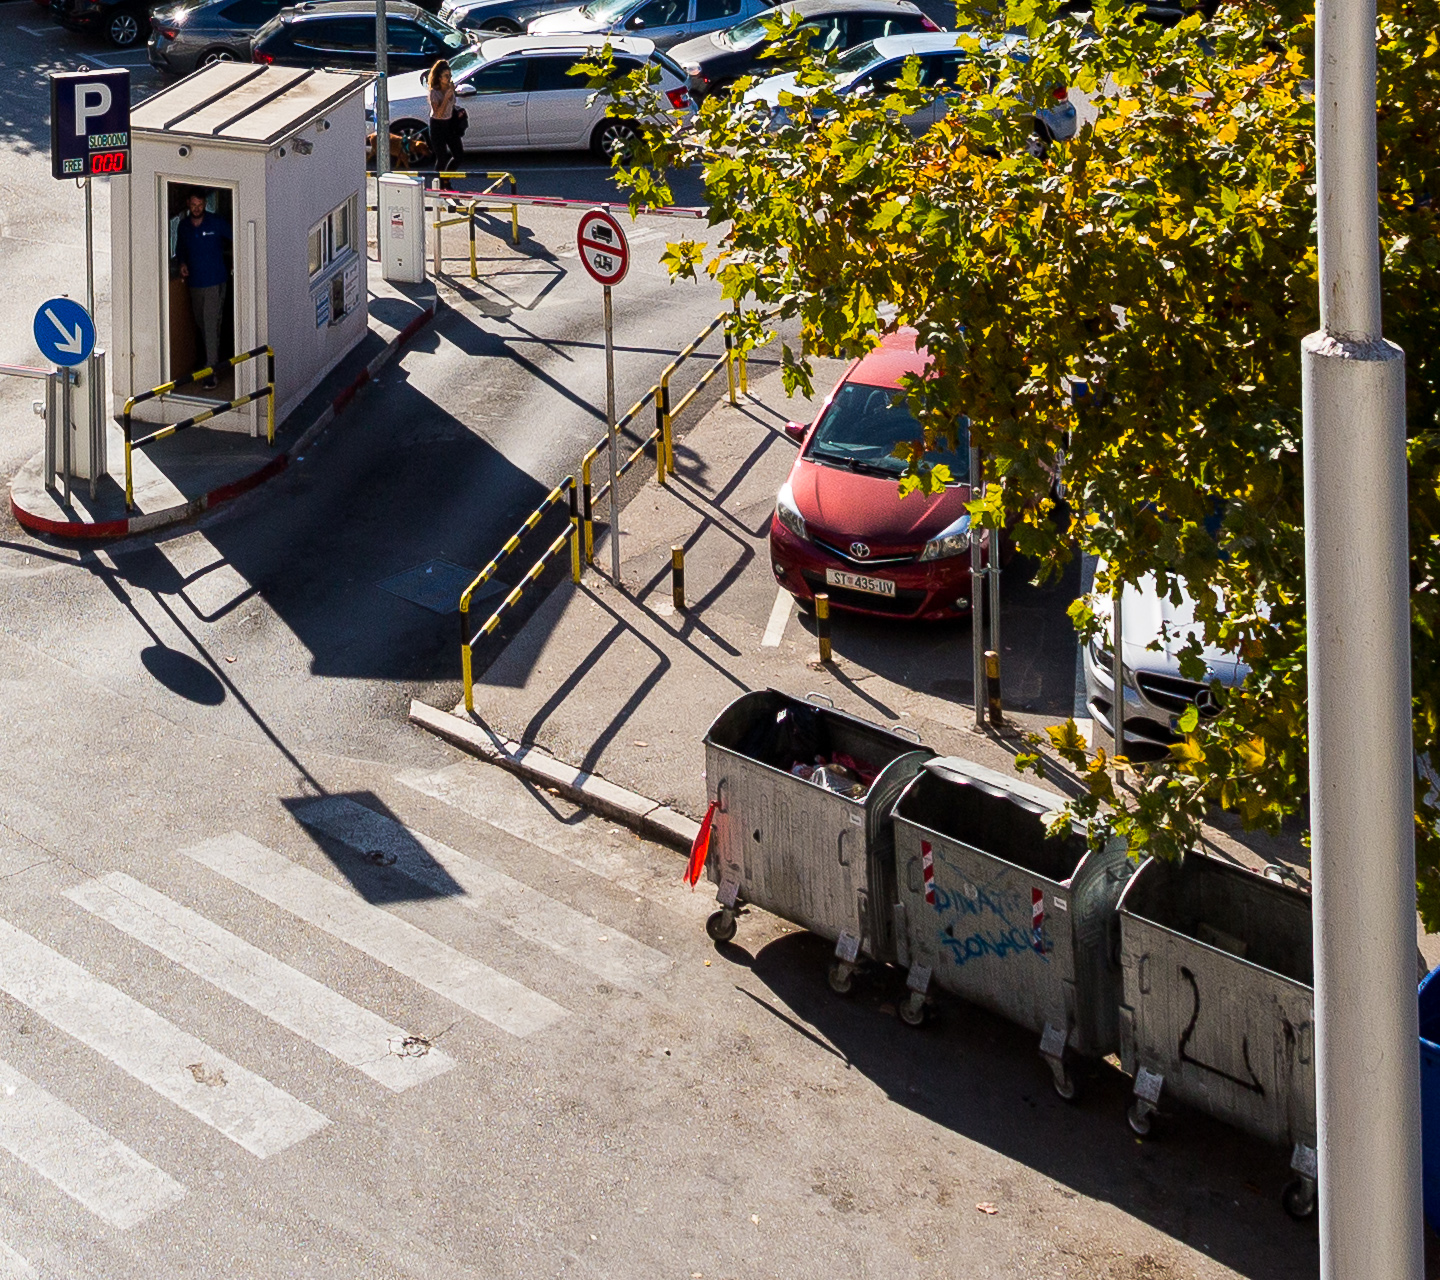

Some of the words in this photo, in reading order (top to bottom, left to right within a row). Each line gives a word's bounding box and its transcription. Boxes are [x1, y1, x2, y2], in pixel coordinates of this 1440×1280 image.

[75, 82, 112, 136] P
[64, 158, 83, 172] FREE
[92, 153, 124, 174] 000
[834, 571, 847, 585] ST
[854, 576, 893, 594] 435-UV
